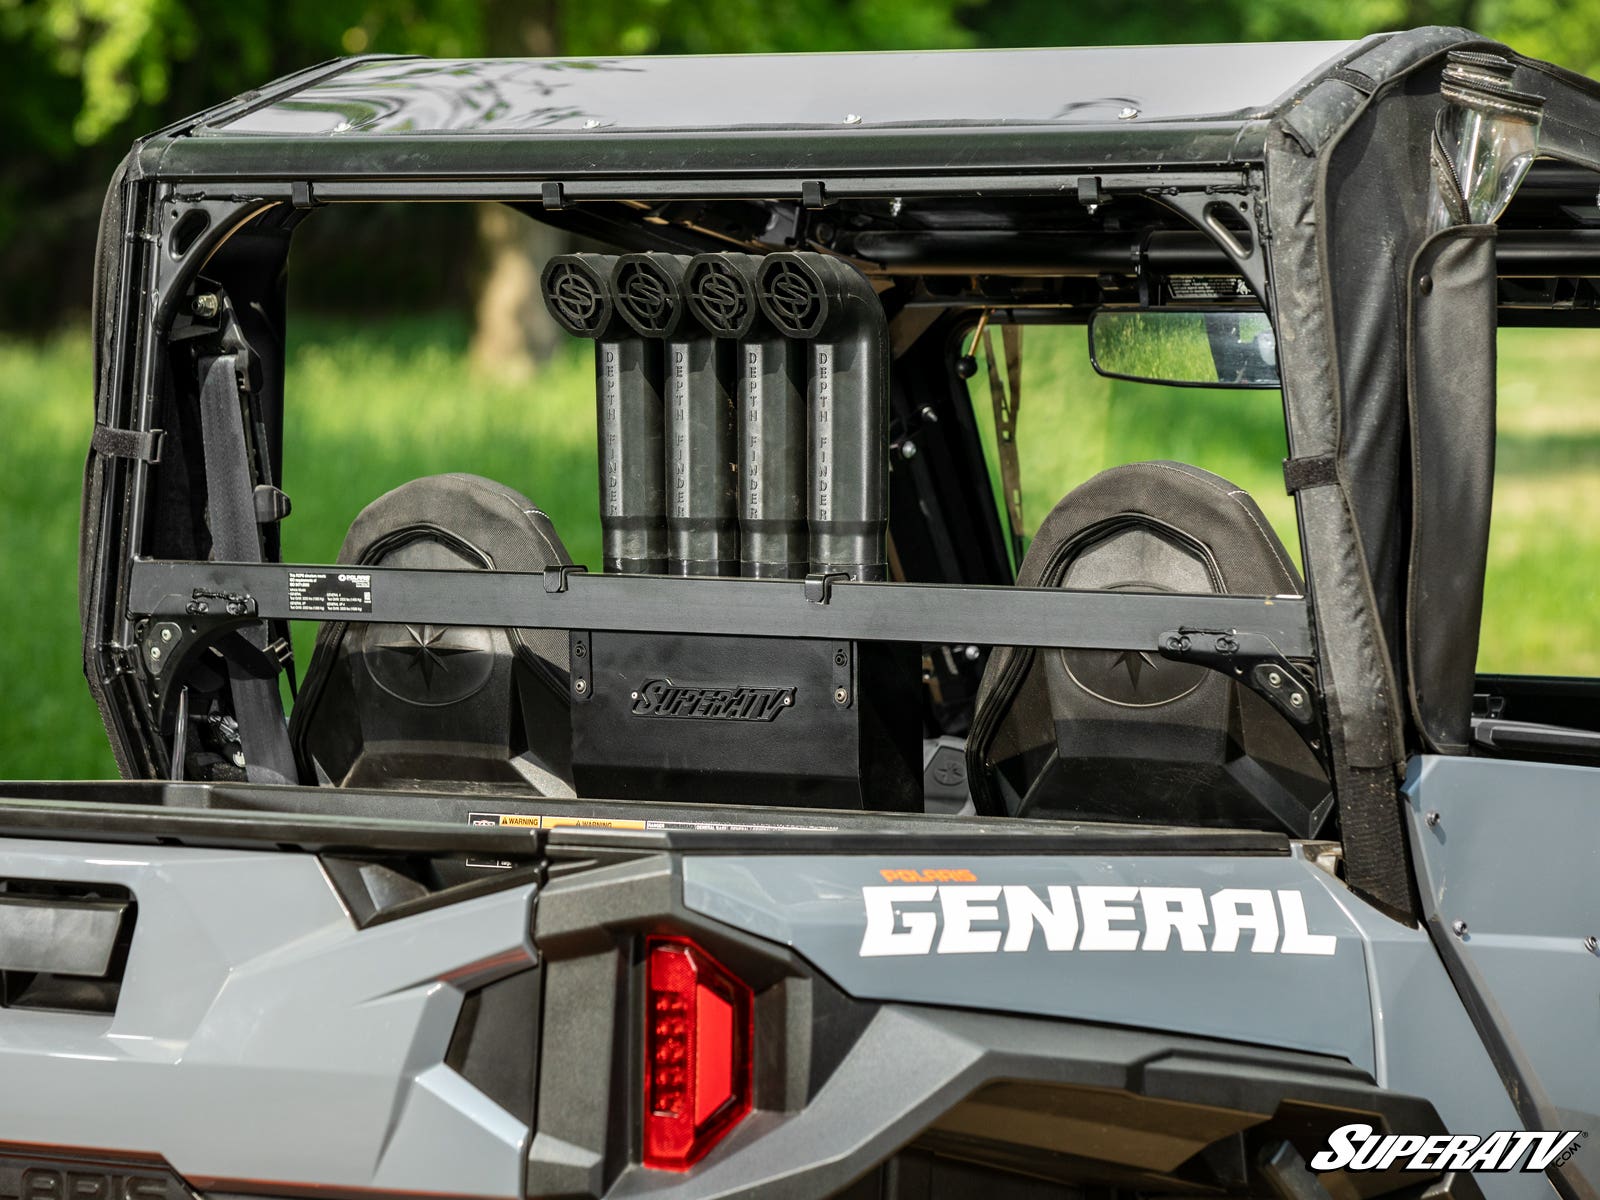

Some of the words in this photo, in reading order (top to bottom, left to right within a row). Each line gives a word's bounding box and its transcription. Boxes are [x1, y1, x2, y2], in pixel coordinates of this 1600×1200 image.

[605, 351, 616, 421] DEPTH
[675, 351, 684, 421] DEPTH
[749, 352, 758, 422] DEPTH
[819, 352, 828, 423] DEPTH
[608, 431, 617, 517] FINDER
[677, 433, 685, 518] FINDER
[750, 436, 758, 519] FINDER
[819, 437, 828, 521] FINDER
[631, 679, 797, 721] SUPERATV
[508, 818, 539, 826] WARNING
[880, 869, 977, 883] POLARIS
[859, 885, 1337, 957] GENERAL
